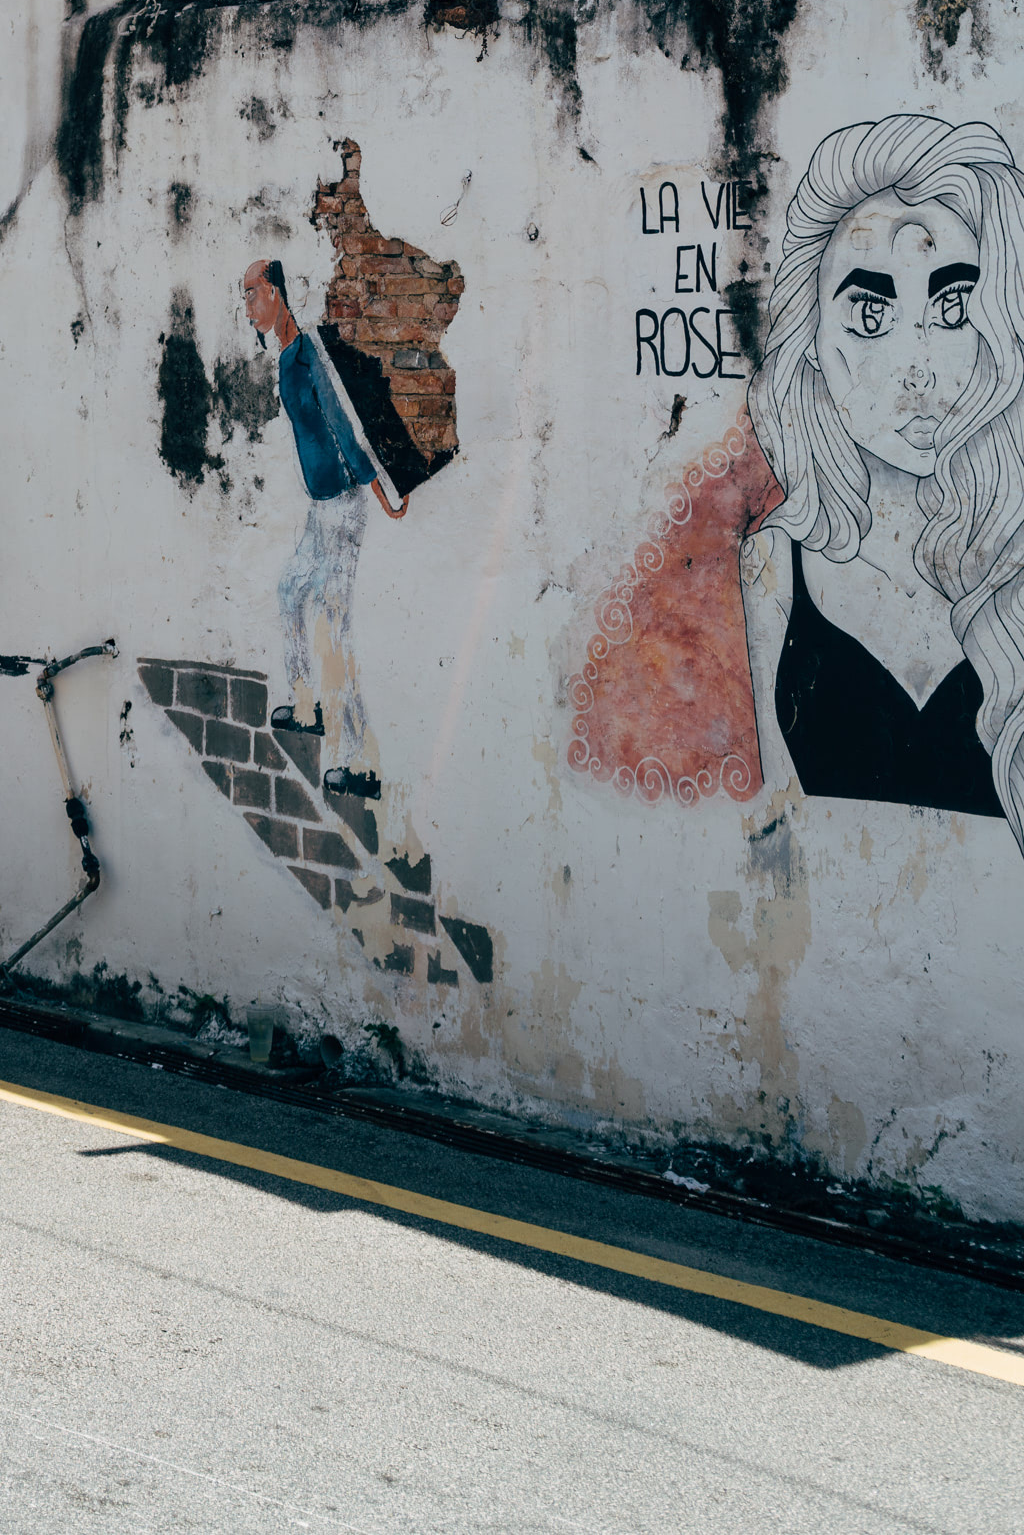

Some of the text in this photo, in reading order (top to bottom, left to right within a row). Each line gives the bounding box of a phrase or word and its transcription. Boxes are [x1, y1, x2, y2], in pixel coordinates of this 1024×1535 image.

[639, 180, 753, 234] LA VIE
[675, 242, 717, 293] EN
[635, 307, 746, 379] ROSE
